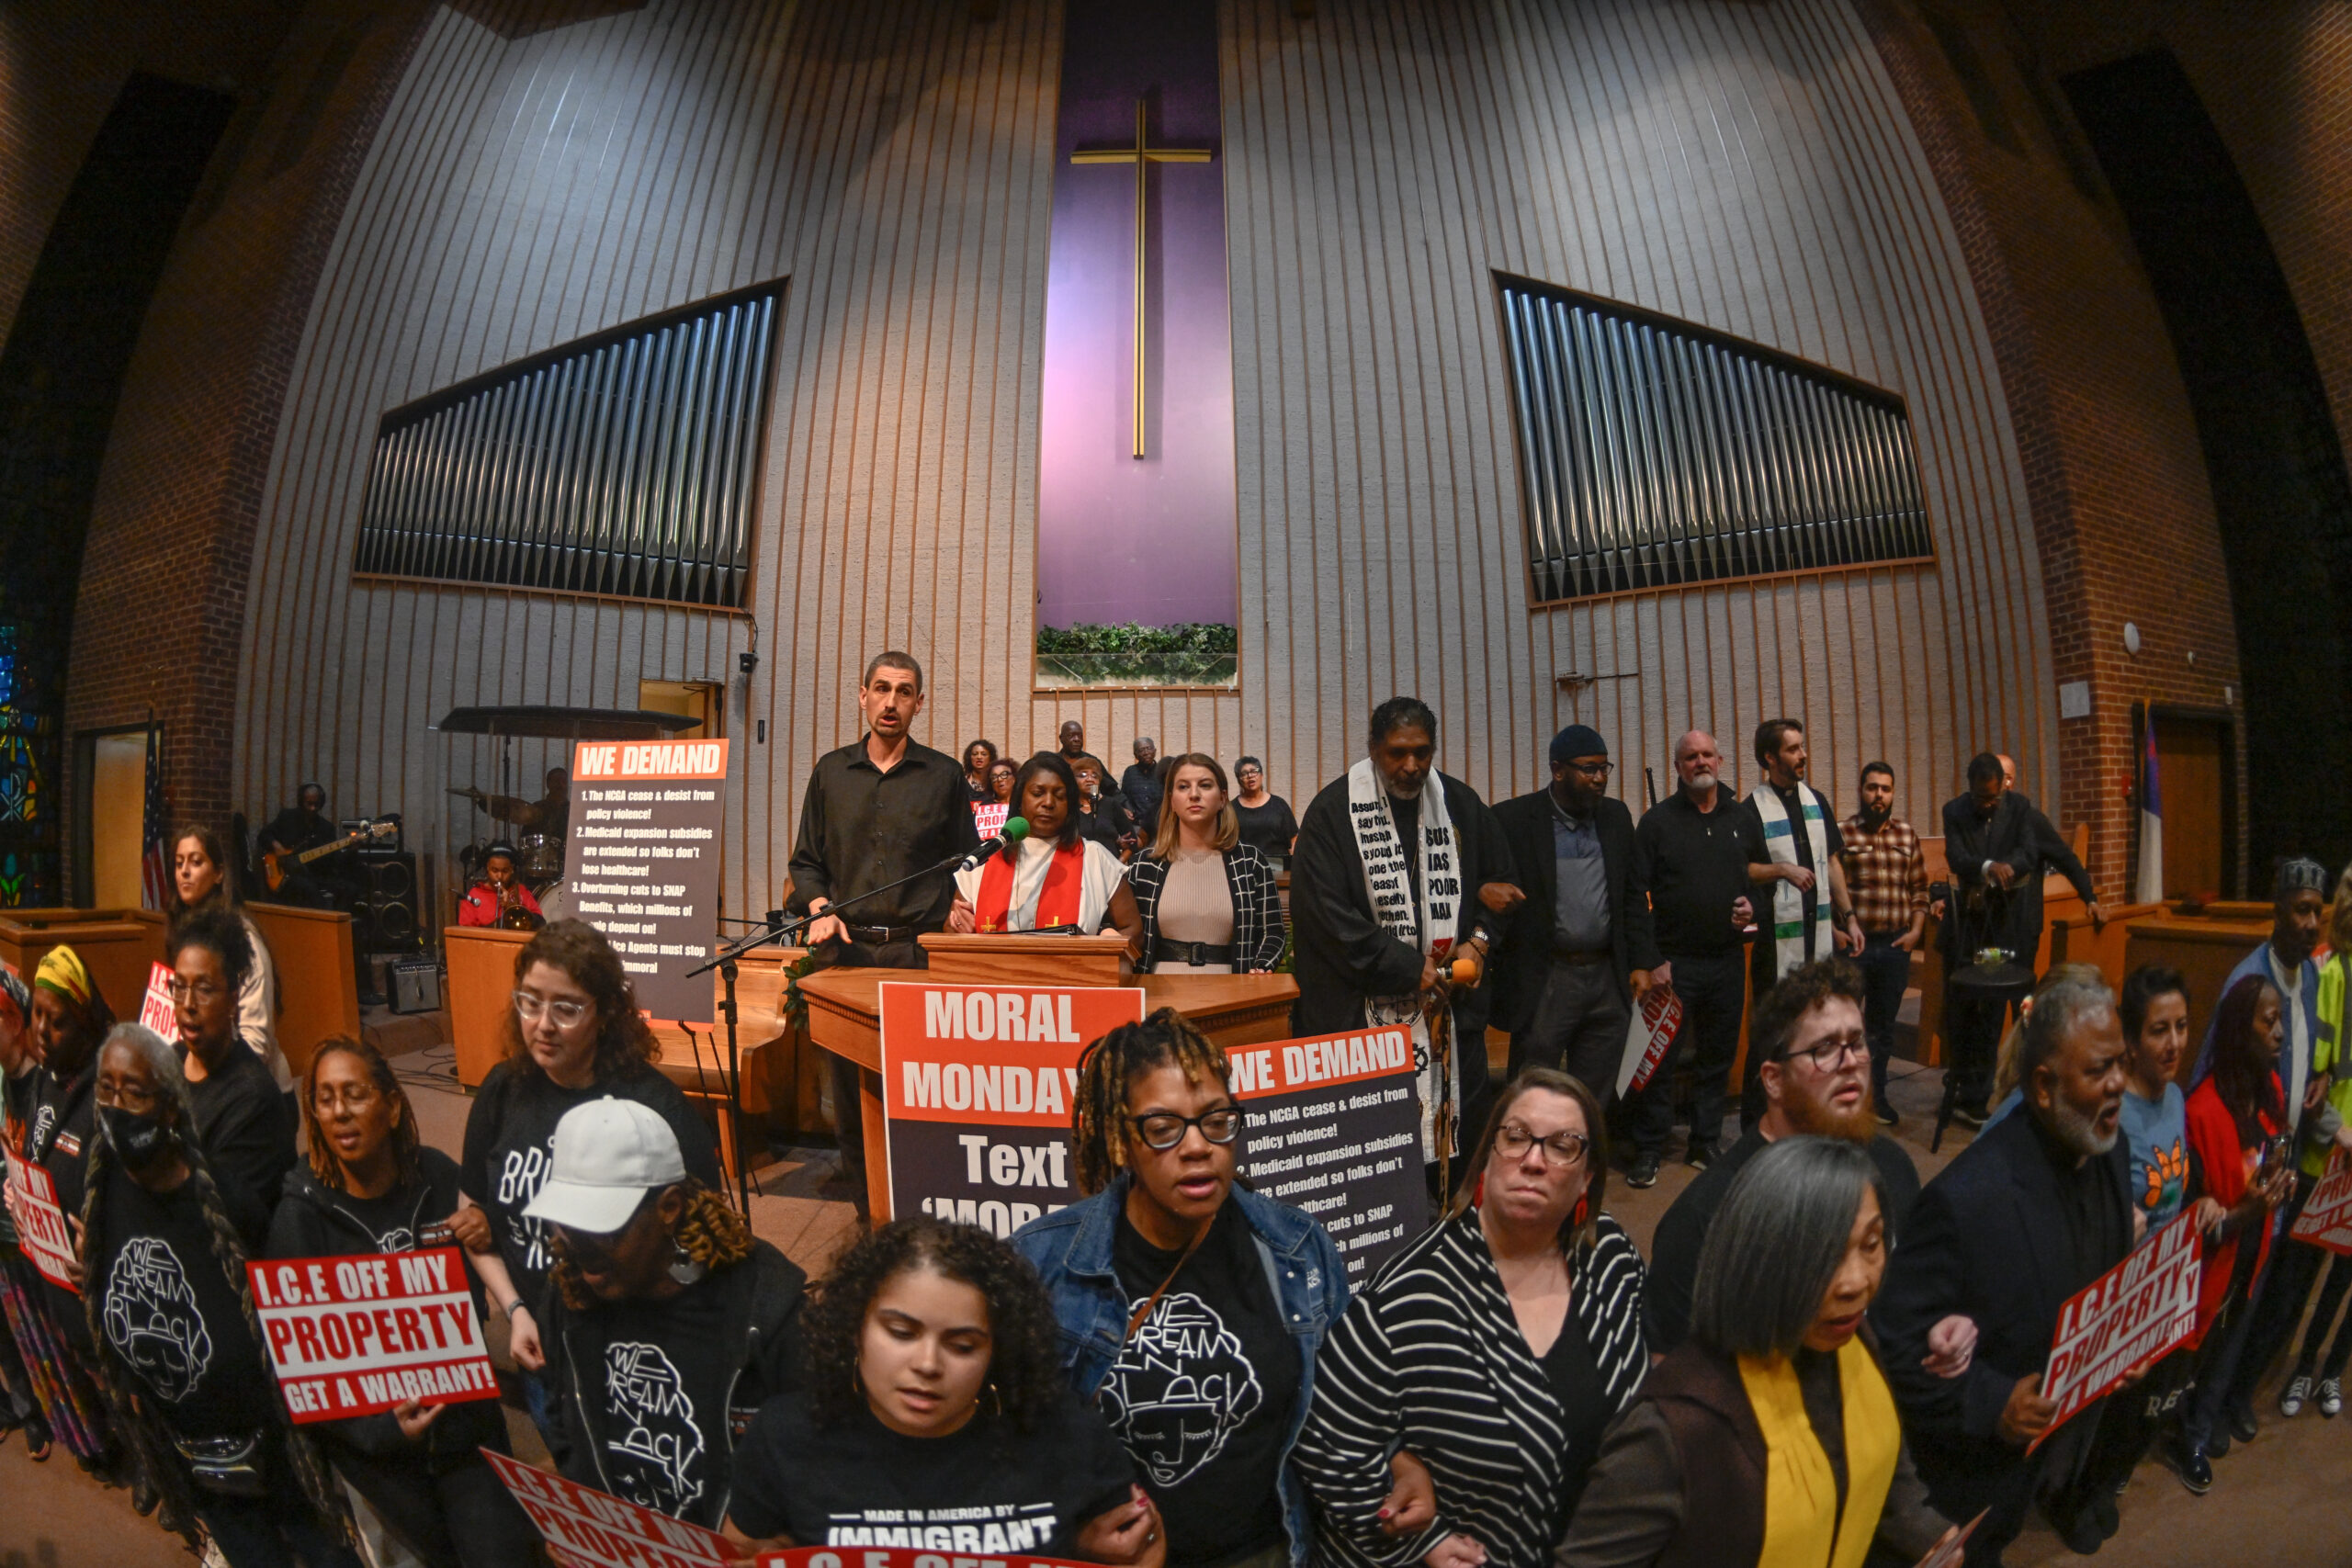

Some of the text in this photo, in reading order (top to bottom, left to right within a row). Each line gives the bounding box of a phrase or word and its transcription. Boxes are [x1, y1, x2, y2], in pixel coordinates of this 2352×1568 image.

[582, 744, 720, 775] WE DEMAND
[582, 790, 715, 801] 1. The NCGA cease & desist from
[586, 808, 651, 820] policy violence!
[977, 815, 1007, 828] PROP
[1358, 817, 1374, 829] say
[576, 827, 713, 840] 2. Medicaid expansion subsidies
[583, 846, 700, 858] are extended so folks don't
[1369, 860, 1406, 875] one the
[582, 863, 650, 876] lose healthcare!
[572, 882, 686, 897] 3. Overturning cuts to SNAP
[1429, 878, 1459, 896] POOR
[579, 900, 693, 916] Benefits, which millions of
[608, 921, 639, 933] depend
[641, 923, 656, 934] on!
[628, 941, 658, 953] Agents
[660, 944, 683, 955] must
[684, 944, 706, 957] stop
[141, 996, 179, 1039] PROP
[924, 990, 1080, 1043] MORAL
[1648, 1030, 1669, 1061] OFF
[1229, 1031, 1407, 1094] WE DEMAND
[1245, 1087, 1408, 1128] The NCGA cease & desist from
[1247, 1122, 1339, 1155] policy violence!
[958, 1134, 1069, 1188] Text
[1250, 1154, 1304, 1178] Medicaid
[1306, 1145, 1363, 1168] expansion
[1364, 1132, 1414, 1154] subsidies
[499, 1146, 552, 1204] BRI
[1275, 1173, 1329, 1197] extended
[1330, 1172, 1344, 1185] so
[1347, 1165, 1374, 1182] folks
[1297, 1192, 1347, 1213] lthcare!
[1327, 1216, 1351, 1233] cuts
[1353, 1213, 1365, 1226] to
[1367, 1204, 1394, 1223] SNAP
[22, 1198, 69, 1251] ERTY
[1350, 1231, 1391, 1250] millions
[1393, 1224, 1404, 1237] of
[133, 1242, 176, 1272] WE
[1347, 1257, 1365, 1272] on!
[123, 1251, 190, 1304] DREAM
[254, 1255, 449, 1306] I.C.E OFF MY
[2058, 1272, 2118, 1344] I.C.E
[2119, 1239, 2156, 1295] OFF
[2156, 1213, 2189, 1266] MY
[116, 1280, 159, 1311] IN
[109, 1297, 203, 1371] BLACK
[266, 1301, 474, 1366] PROPERTY
[2044, 1258, 2185, 1401] PROPERTY
[616, 1347, 672, 1382] WE
[284, 1360, 496, 1413] GET A WARRANT!
[1100, 1371, 1248, 1427] BLACK
[2065, 1383, 2082, 1415] A
[608, 1427, 697, 1495] ACK
[492, 1456, 580, 1511] I.C.E
[577, 1489, 646, 1536] OFF
[651, 1515, 723, 1562] MY
[864, 1504, 1015, 1522] MADE IN AMERICA BY
[829, 1516, 1057, 1554] IMMIGRANT
